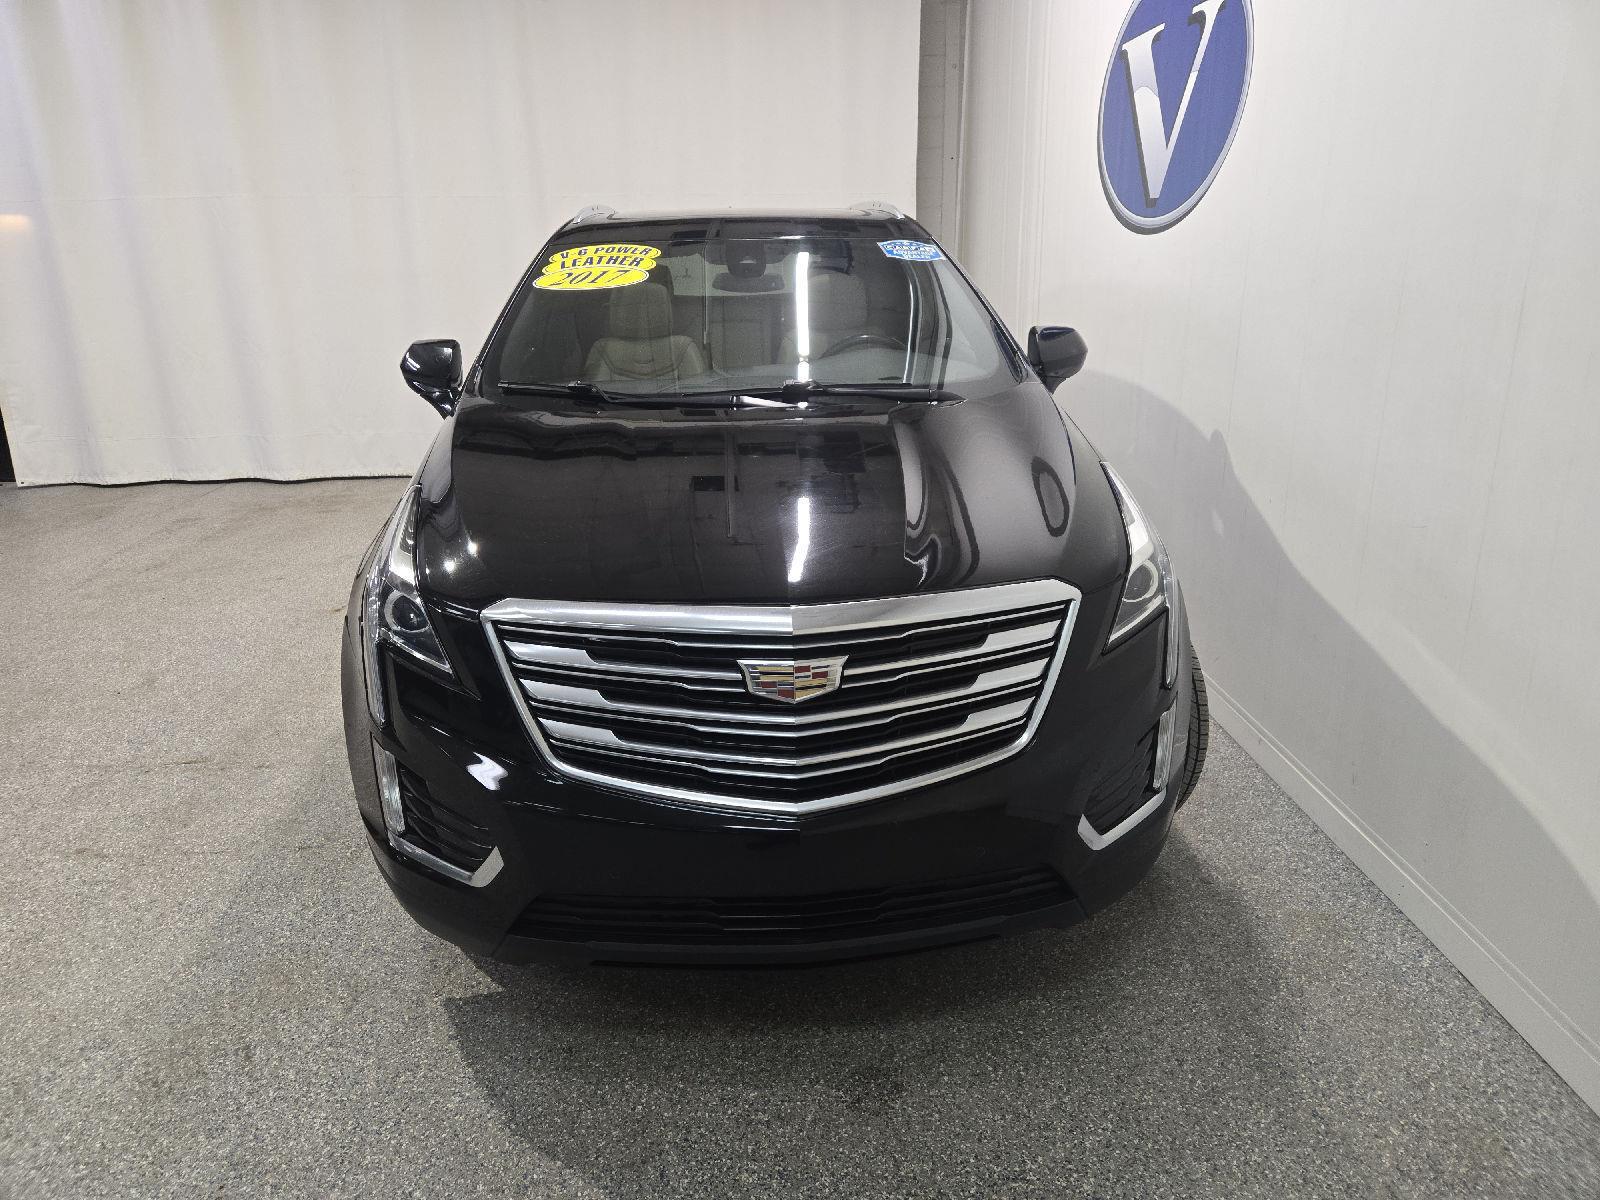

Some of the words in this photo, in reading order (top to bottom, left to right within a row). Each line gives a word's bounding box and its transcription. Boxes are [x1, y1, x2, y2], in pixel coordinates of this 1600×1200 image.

[1122, 0, 1226, 199] V
[594, 246, 652, 256] POWER
[560, 255, 644, 270] LEATHER
[547, 269, 631, 286] 2017
